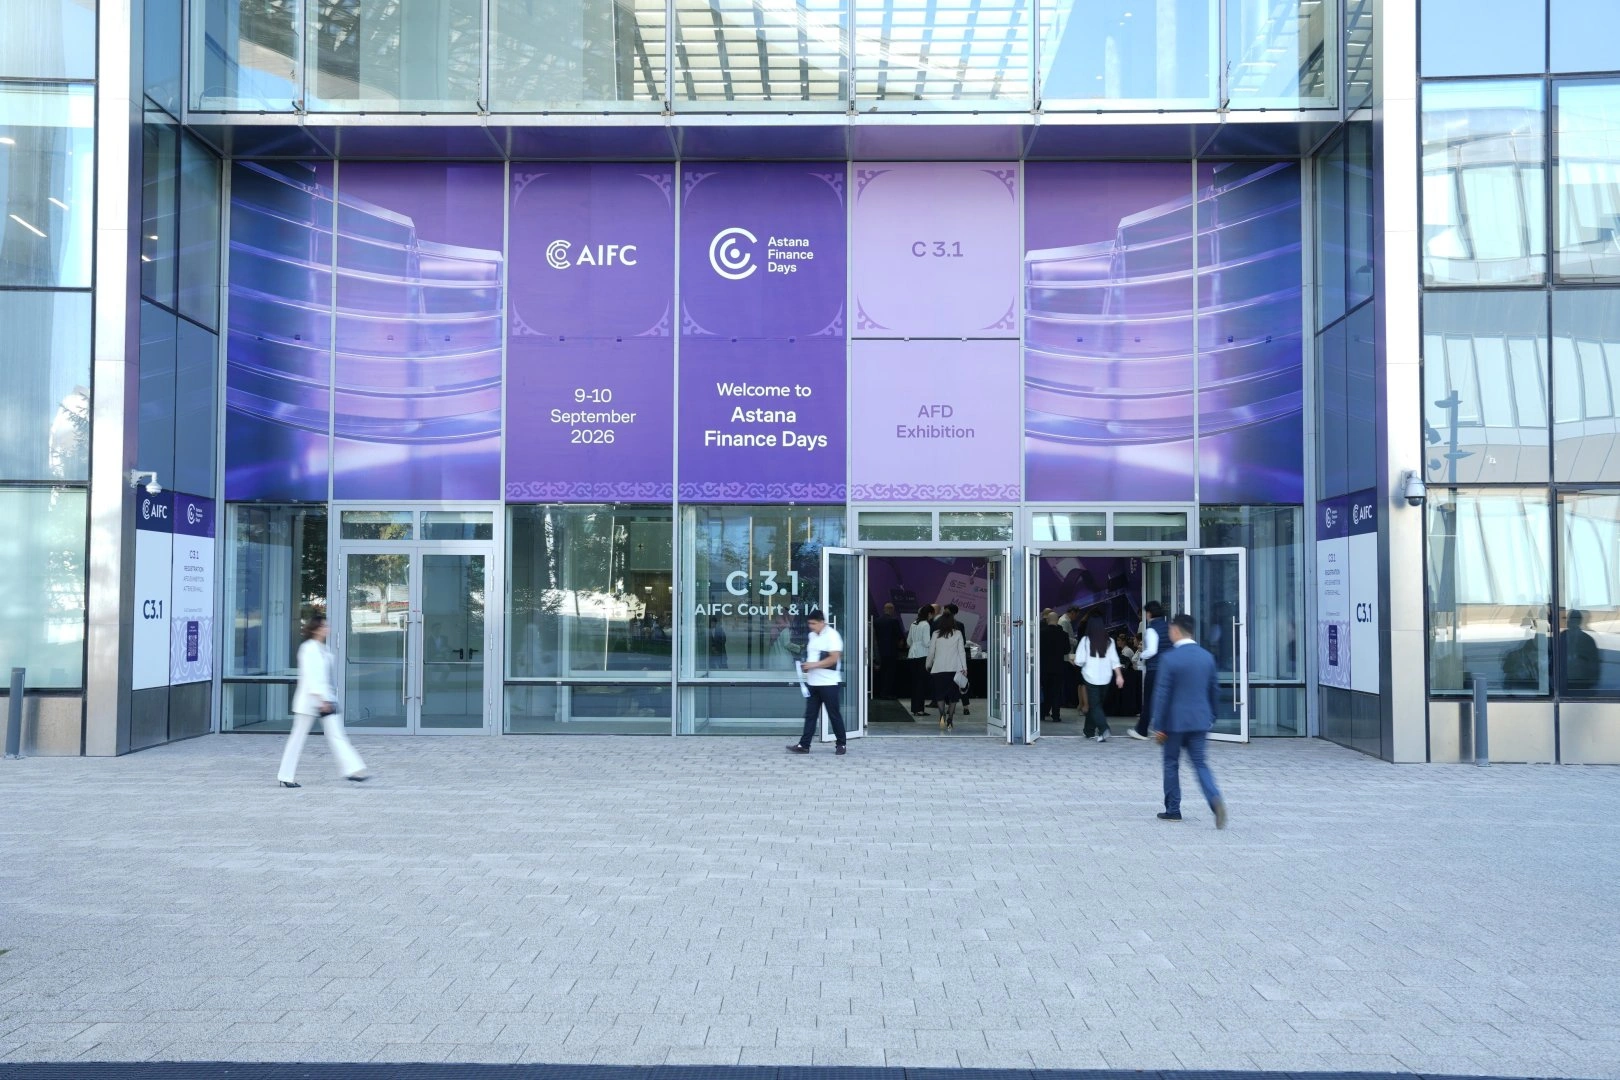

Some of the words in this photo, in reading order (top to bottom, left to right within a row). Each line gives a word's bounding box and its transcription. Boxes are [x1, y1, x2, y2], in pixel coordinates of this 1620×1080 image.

[767, 236, 810, 247] Astana
[576, 244, 638, 266] AIFC
[767, 248, 814, 260] Finance
[911, 241, 928, 258] C
[932, 241, 964, 258] 3.1
[767, 261, 797, 275] Days
[574, 388, 612, 403] 9-10
[716, 382, 790, 397] Welcome
[794, 383, 812, 397] to
[550, 409, 636, 427] September
[730, 406, 797, 423] Astana
[918, 404, 953, 418] AFD
[570, 430, 615, 445] 2026
[897, 424, 975, 439] Exhibition
[704, 431, 777, 448] Finance
[782, 431, 828, 451] Days
[150, 504, 168, 519] AIFC
[1359, 504, 1373, 520] AIFC
[725, 570, 749, 596] C
[758, 570, 799, 596] 3.1
[143, 599, 163, 620] C3.1
[694, 603, 733, 616] AIFC
[737, 603, 784, 616] Court
[787, 603, 800, 616] &
[1356, 603, 1372, 623] C3.1
